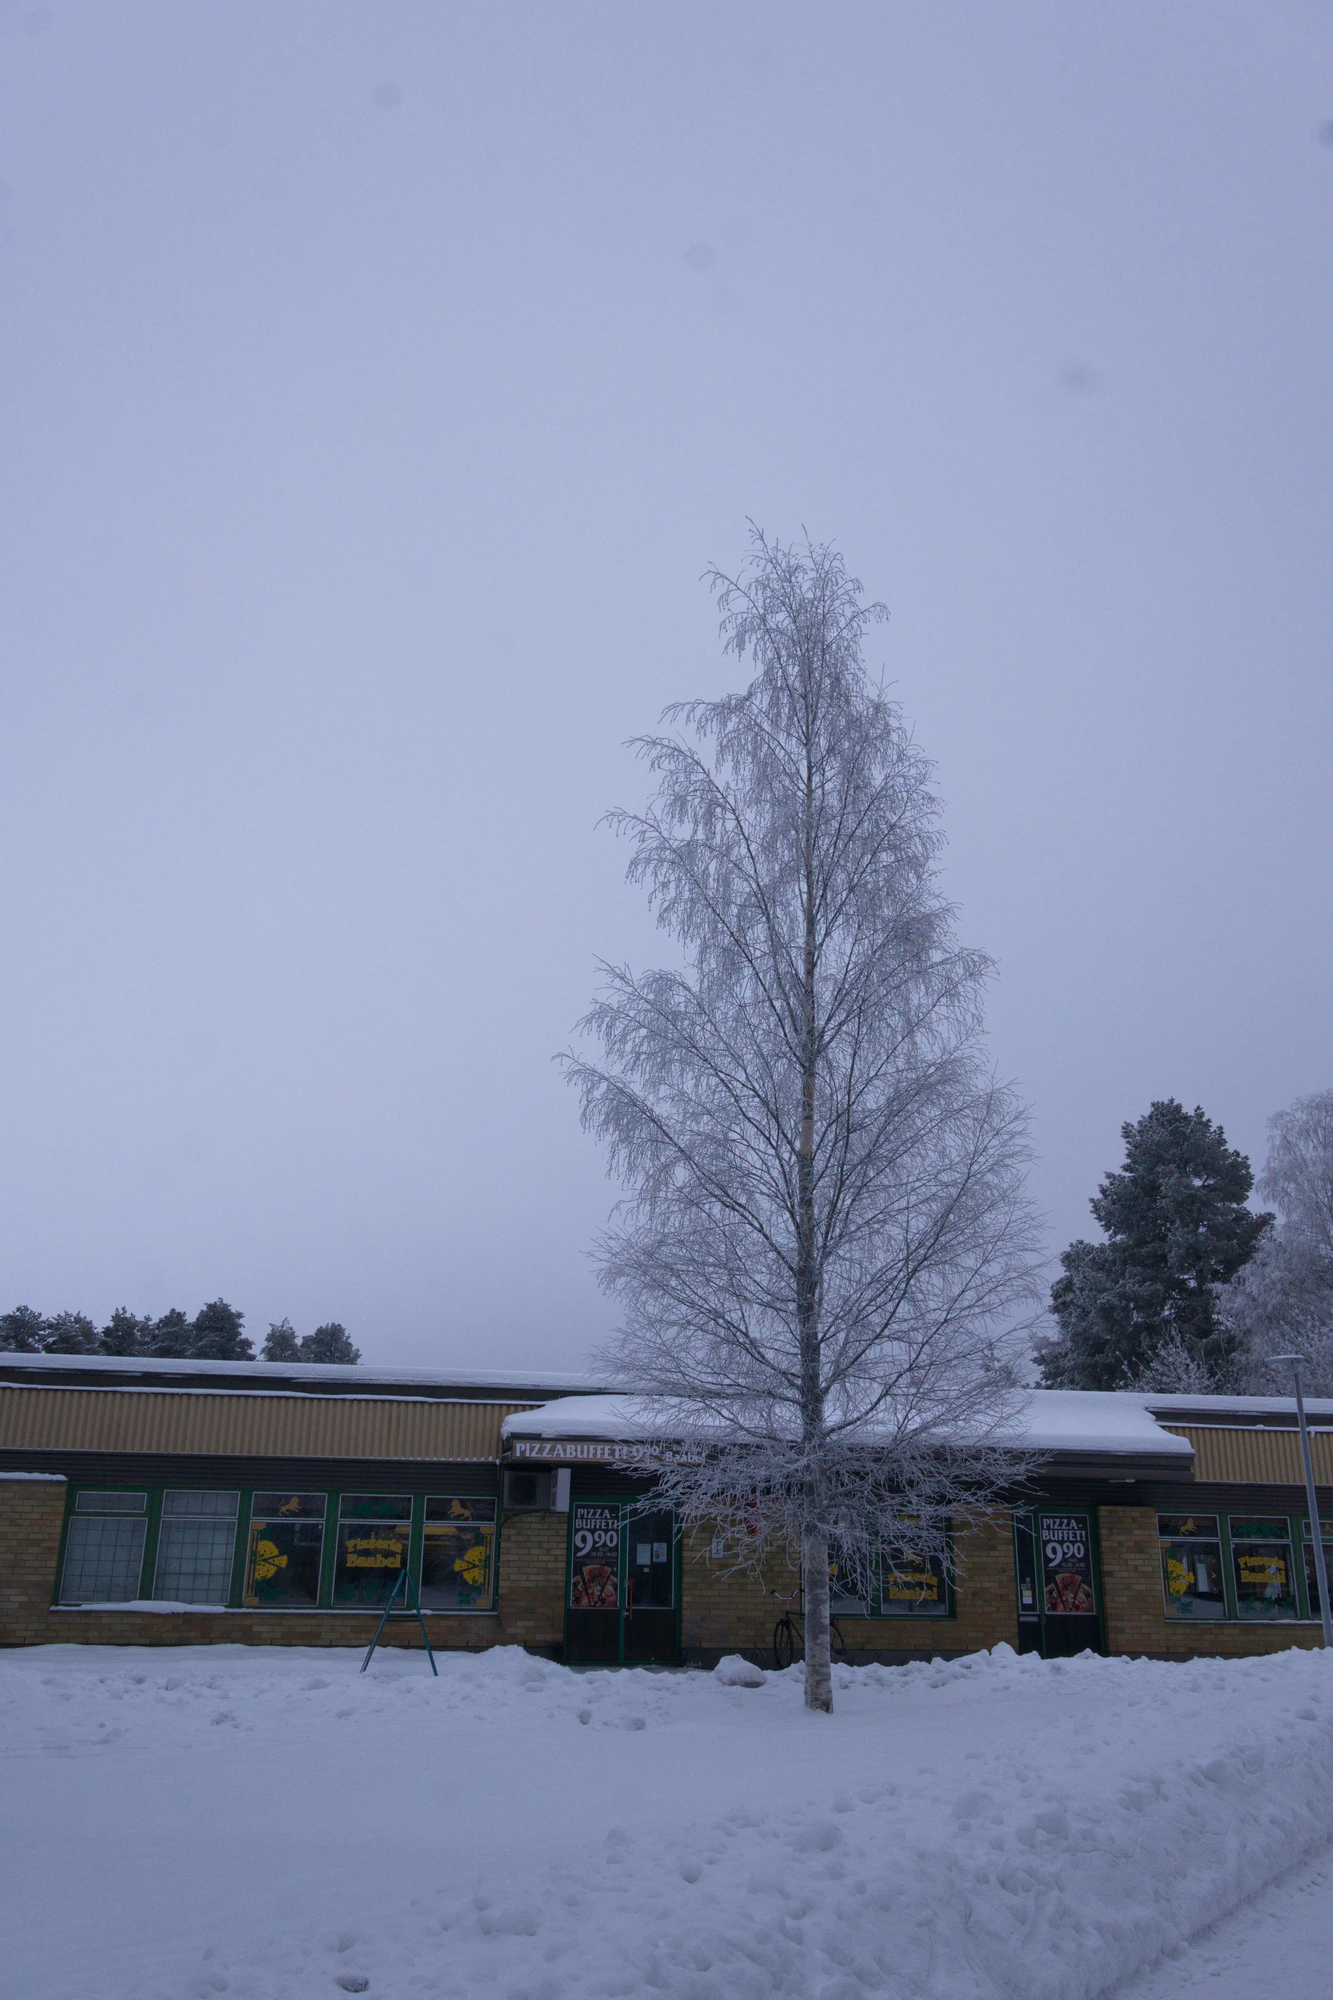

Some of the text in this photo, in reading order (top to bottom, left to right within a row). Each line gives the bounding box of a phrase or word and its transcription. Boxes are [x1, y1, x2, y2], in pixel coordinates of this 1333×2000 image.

[577, 1508, 616, 1519] PIZZA-
[575, 1519, 618, 1529] BUFFET!
[1042, 1518, 1083, 1530] PIZZA-
[1042, 1530, 1086, 1541] BUFFET!
[346, 1554, 401, 1568] Baabel
